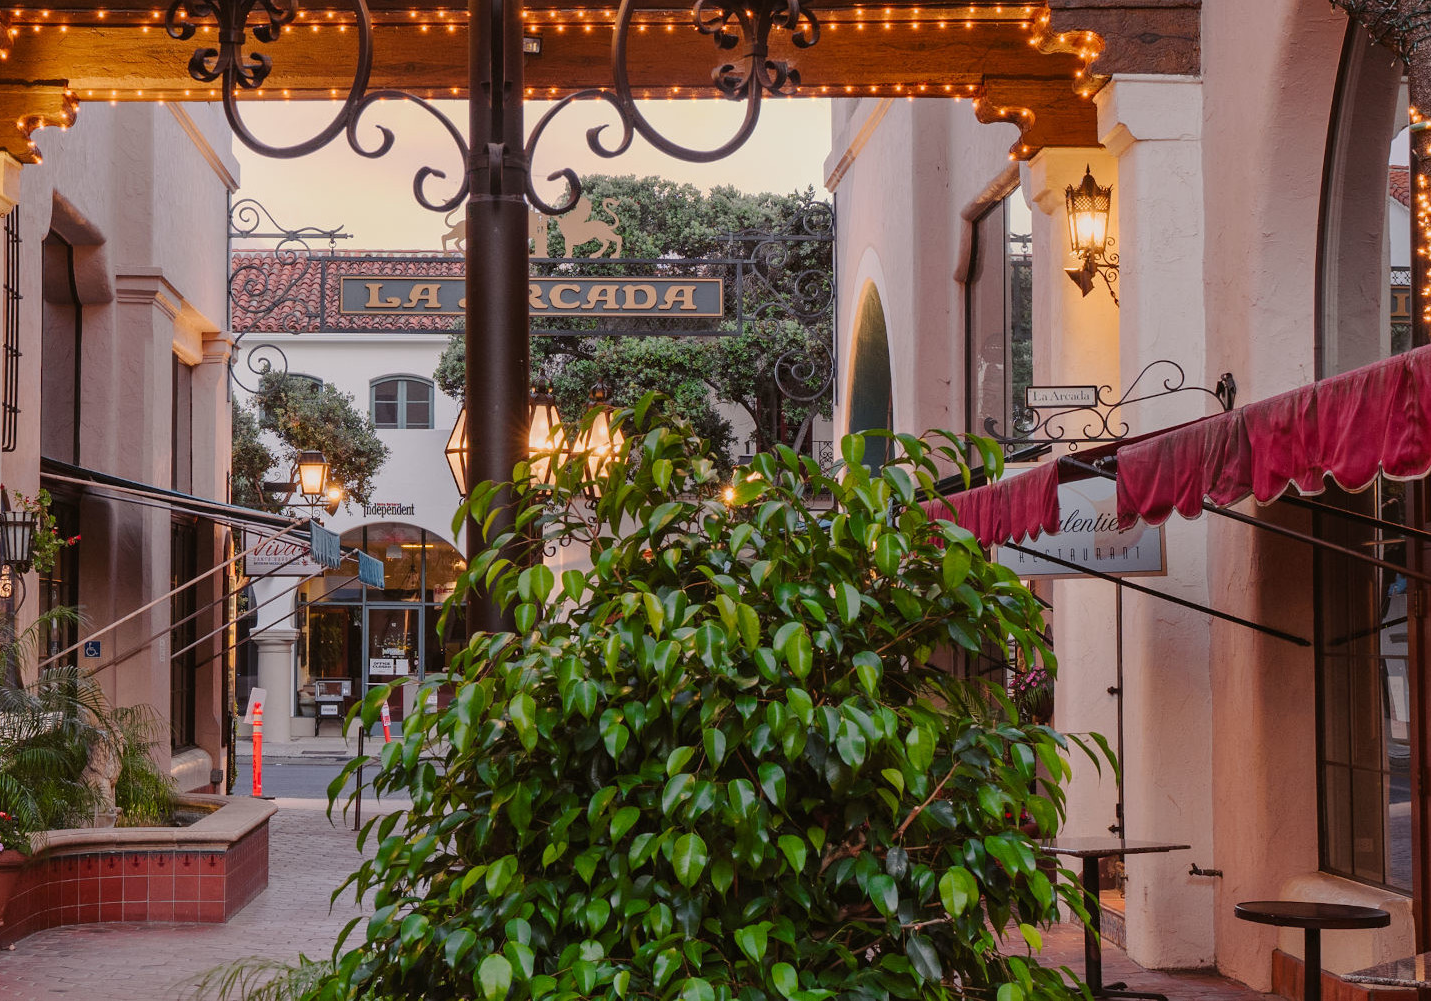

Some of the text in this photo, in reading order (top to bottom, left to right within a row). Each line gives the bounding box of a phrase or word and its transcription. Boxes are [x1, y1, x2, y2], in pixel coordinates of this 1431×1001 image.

[365, 283, 698, 310] LA RCADA
[1033, 390, 1090, 401] La Arcada
[363, 503, 415, 518] Independent
